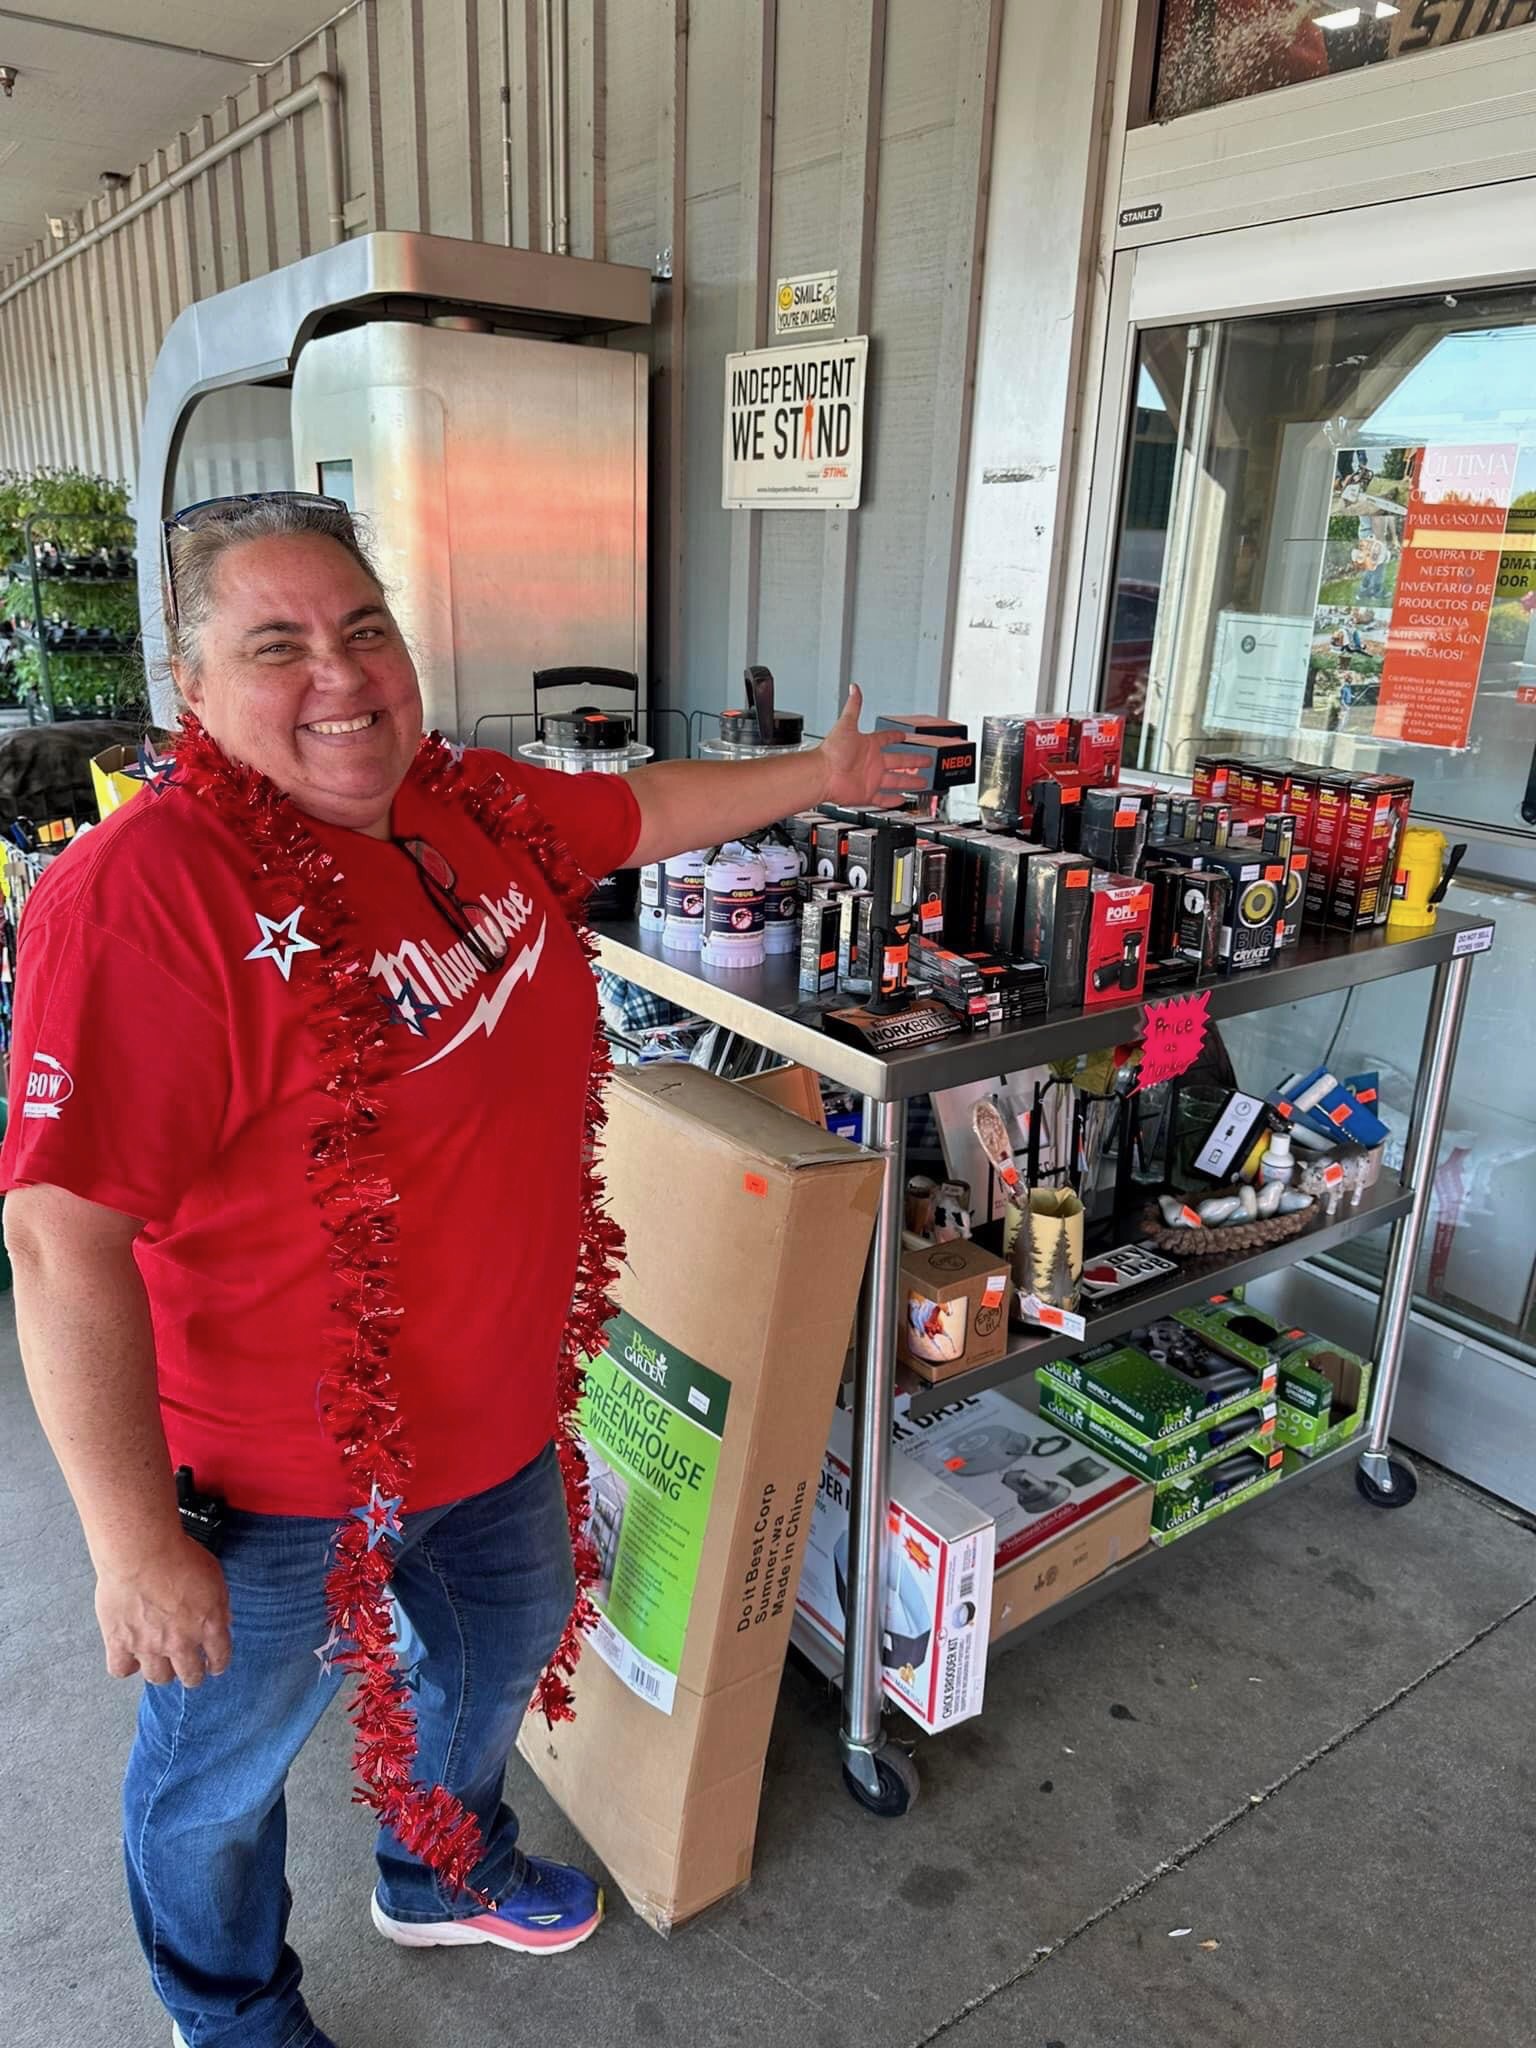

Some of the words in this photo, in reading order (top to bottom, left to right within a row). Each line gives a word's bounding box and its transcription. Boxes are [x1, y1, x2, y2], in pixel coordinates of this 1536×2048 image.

[1122, 208, 1159, 223] STANLEY
[794, 283, 823, 305] SMILE
[778, 311, 799, 327] YOU'RE
[801, 310, 809, 324] ON
[811, 306, 836, 323] CAMERA
[732, 358, 856, 407] INDEPENDENT
[732, 410, 765, 461] WE
[1408, 513, 1439, 525] PARA
[1415, 549, 1466, 560] COMPRA
[1470, 551, 1485, 560] DE
[1420, 566, 1475, 577] NUESTRO
[1400, 582, 1472, 594] INVENTARIO
[1476, 584, 1492, 594] DE
[1398, 597, 1468, 610] PRODUCTOS
[1472, 601, 1488, 611] DE
[1409, 614, 1469, 627] GASOLINA
[1391, 630, 1452, 641] MIENTRAS
[942, 755, 972, 770] NEBO
[1114, 890, 1136, 898] NEBO
[1234, 925, 1273, 951] BIG
[1233, 946, 1271, 961] CRYKET
[867, 1013, 952, 1043] WORKBRITE
[27, 1072, 65, 1098] BOW
[632, 1331, 657, 1362] Best
[624, 1346, 666, 1387] GARDEN
[611, 1371, 672, 1434] LARGE
[585, 1376, 705, 1490] GREENHOUSE
[590, 1409, 617, 1446] WITH
[616, 1439, 682, 1501] SHELVING
[754, 1483, 776, 1533] Corp
[786, 1481, 807, 1539] China
[746, 1537, 765, 1584] Best
[781, 1542, 795, 1562] in
[743, 1586, 756, 1602] it
[772, 1564, 791, 1617] Made
[737, 1605, 752, 1632] Do
